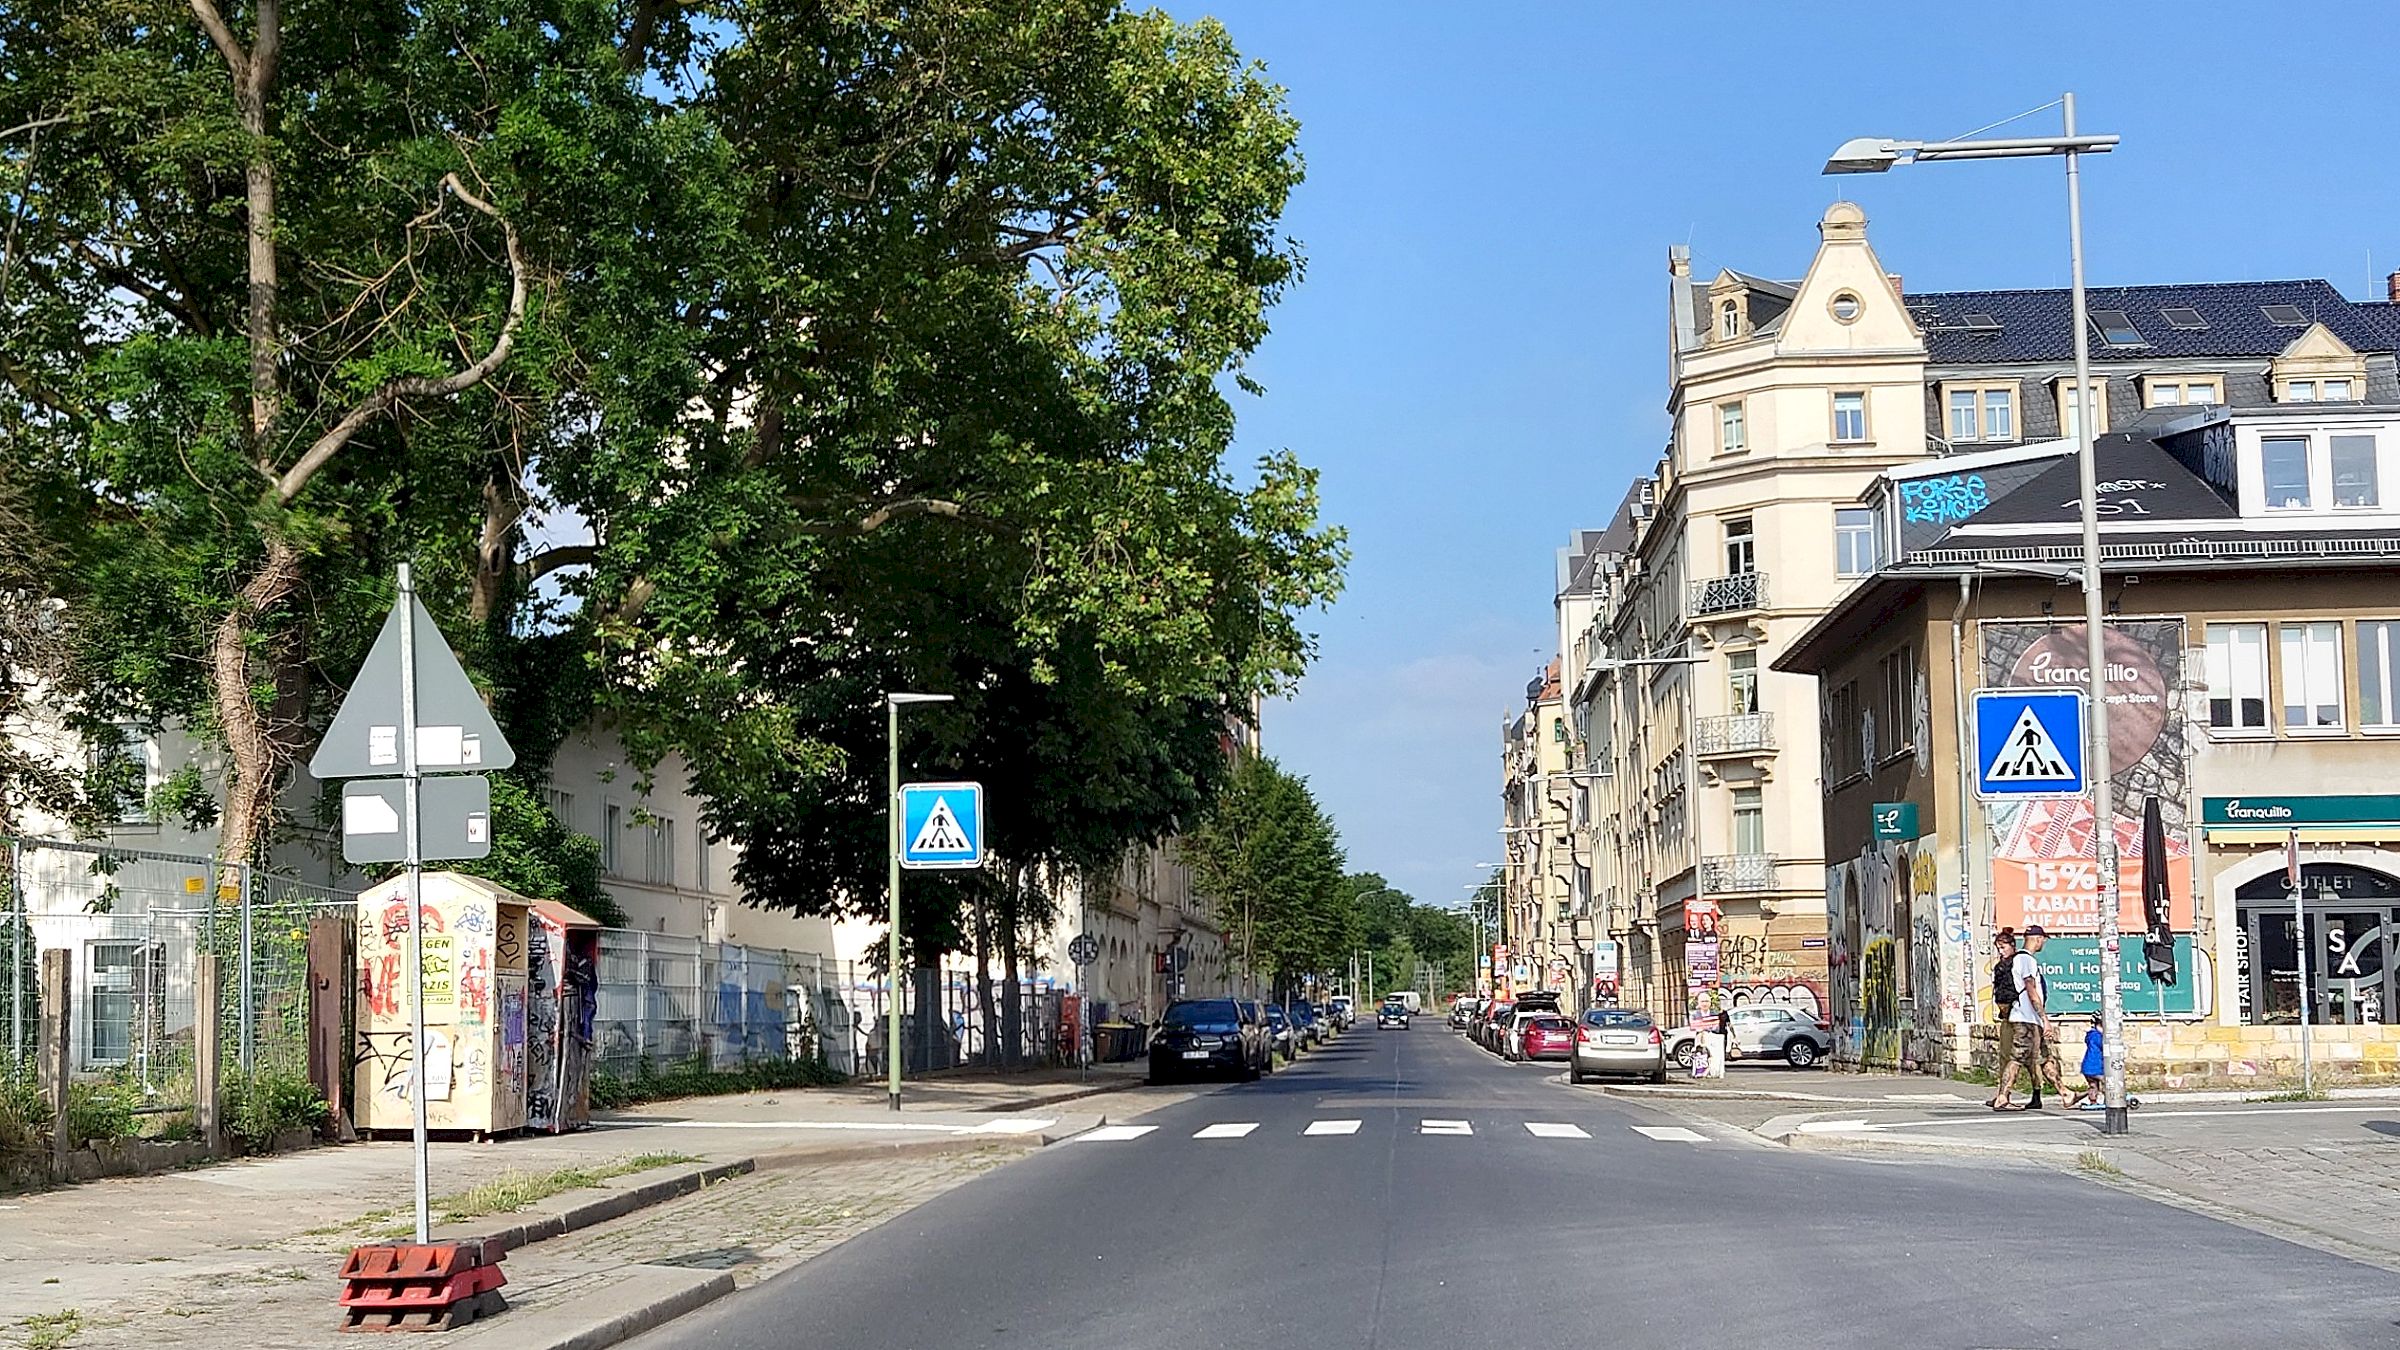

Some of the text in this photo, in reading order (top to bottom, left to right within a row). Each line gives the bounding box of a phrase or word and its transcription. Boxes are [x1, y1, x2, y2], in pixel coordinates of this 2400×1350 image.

[2029, 652, 2138, 683] tranqillo
[2128, 693, 2158, 703] Store
[2225, 800, 2292, 818] tranquillo
[2280, 876, 2354, 889] OUTLET
[2023, 896, 2098, 912] RABATT
[2022, 914, 2099, 927] AUF ALLES
[423, 940, 450, 948] GEN
[2236, 926, 2249, 969] SHOP
[422, 981, 449, 990] AZIS
[2052, 981, 2091, 991] Montag
[2238, 974, 2251, 1007] FAIR
[2071, 992, 2083, 1003] 10
